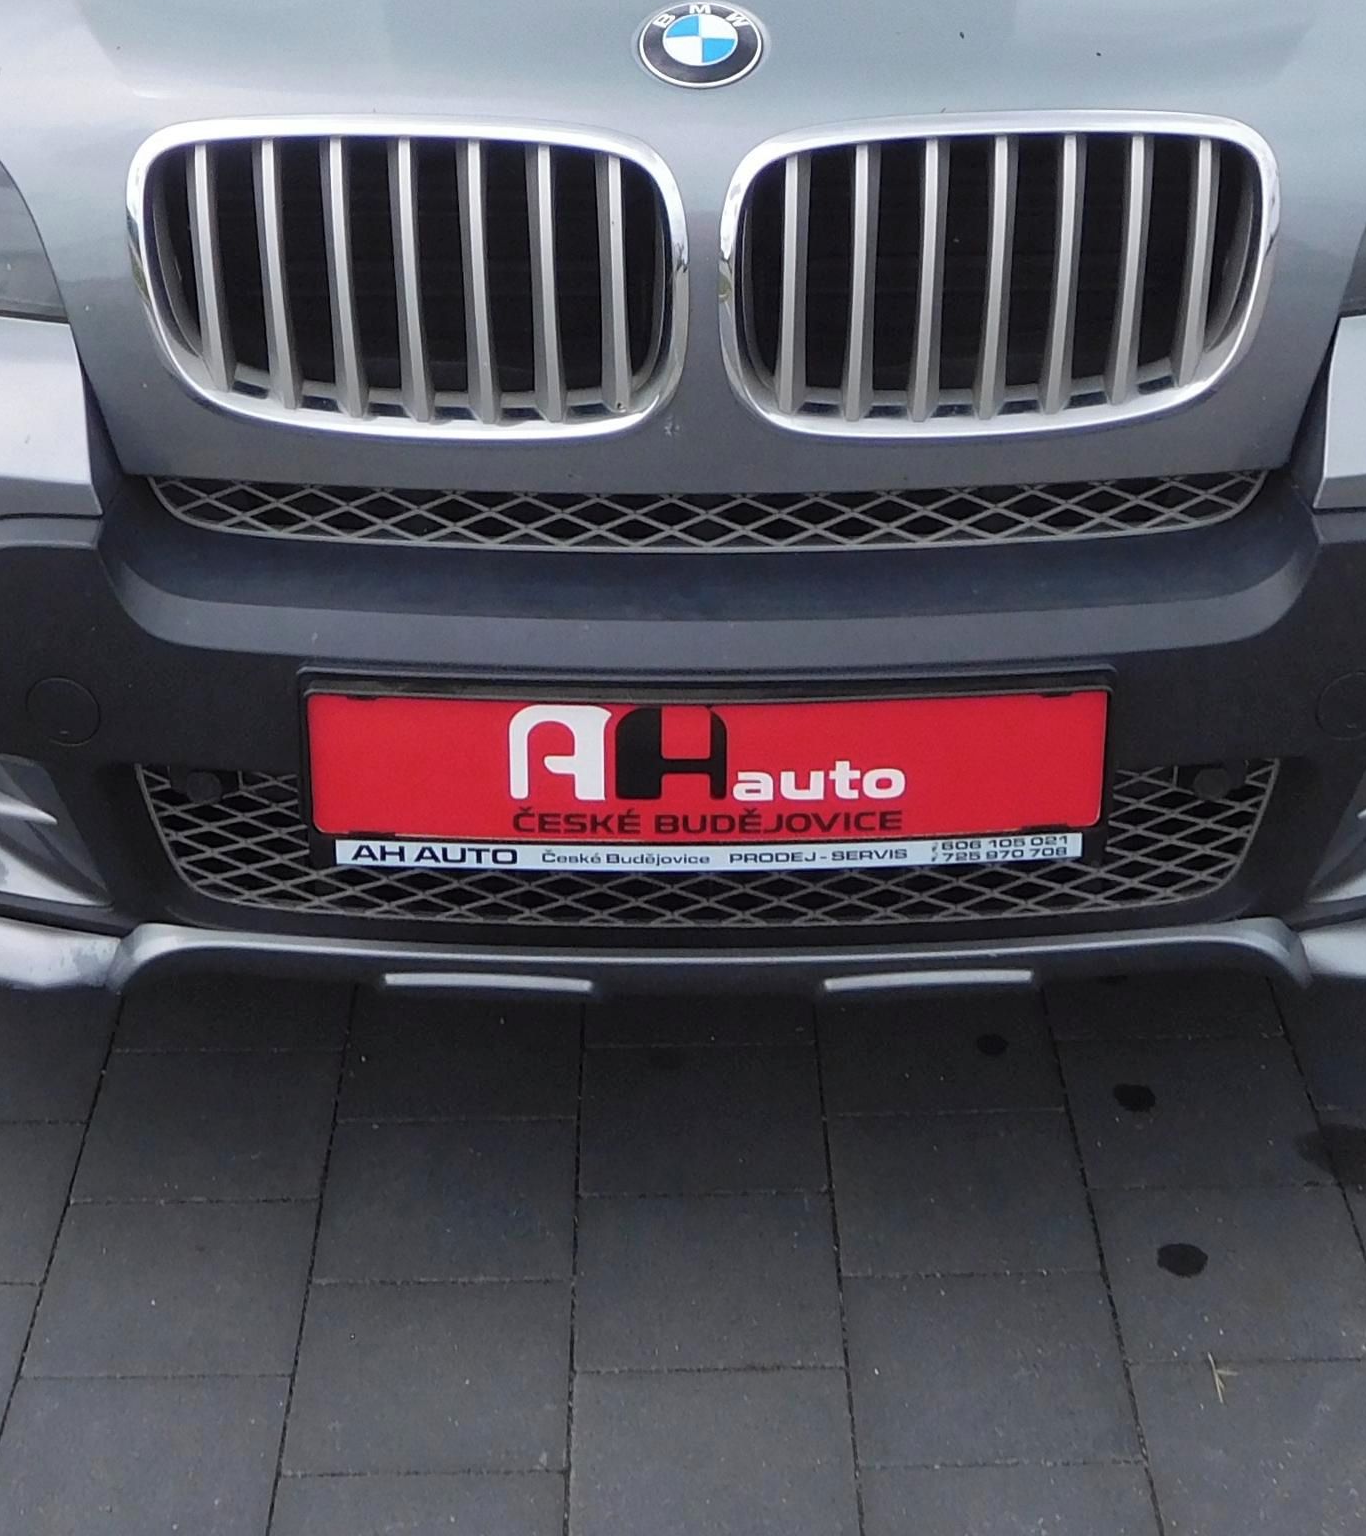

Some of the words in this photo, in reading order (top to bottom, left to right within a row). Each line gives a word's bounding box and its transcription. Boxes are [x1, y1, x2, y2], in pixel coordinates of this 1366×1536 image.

[651, 3, 752, 29] BMW
[513, 806, 641, 834] ČESKÉ
[654, 807, 903, 835] BUDĚJOVICE
[941, 839, 982, 851] 606
[988, 837, 1026, 849] 105
[1030, 835, 1068, 846] 021
[351, 844, 406, 862] AH
[414, 845, 518, 864] AUTO
[541, 848, 602, 864] České
[606, 852, 711, 866] Budějovice
[942, 851, 981, 863] 725
[986, 849, 1024, 860] 970
[1029, 846, 1067, 857] 708
